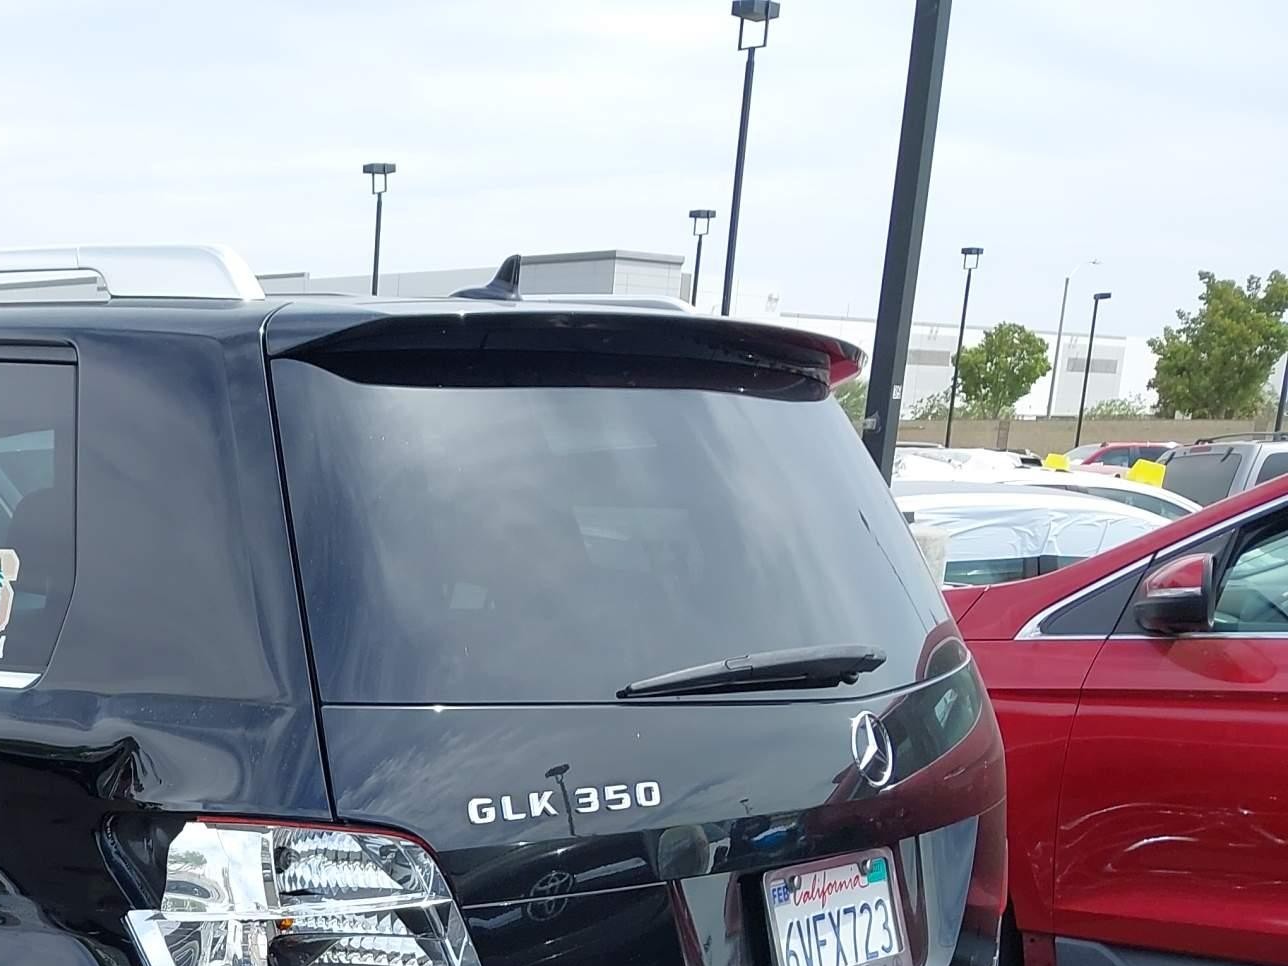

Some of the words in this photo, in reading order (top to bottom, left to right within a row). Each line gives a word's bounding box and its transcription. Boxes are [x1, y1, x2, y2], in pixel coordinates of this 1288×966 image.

[467, 790, 559, 825] GLK
[574, 780, 661, 814] 350
[771, 886, 791, 904] FEB
[793, 866, 870, 909] California
